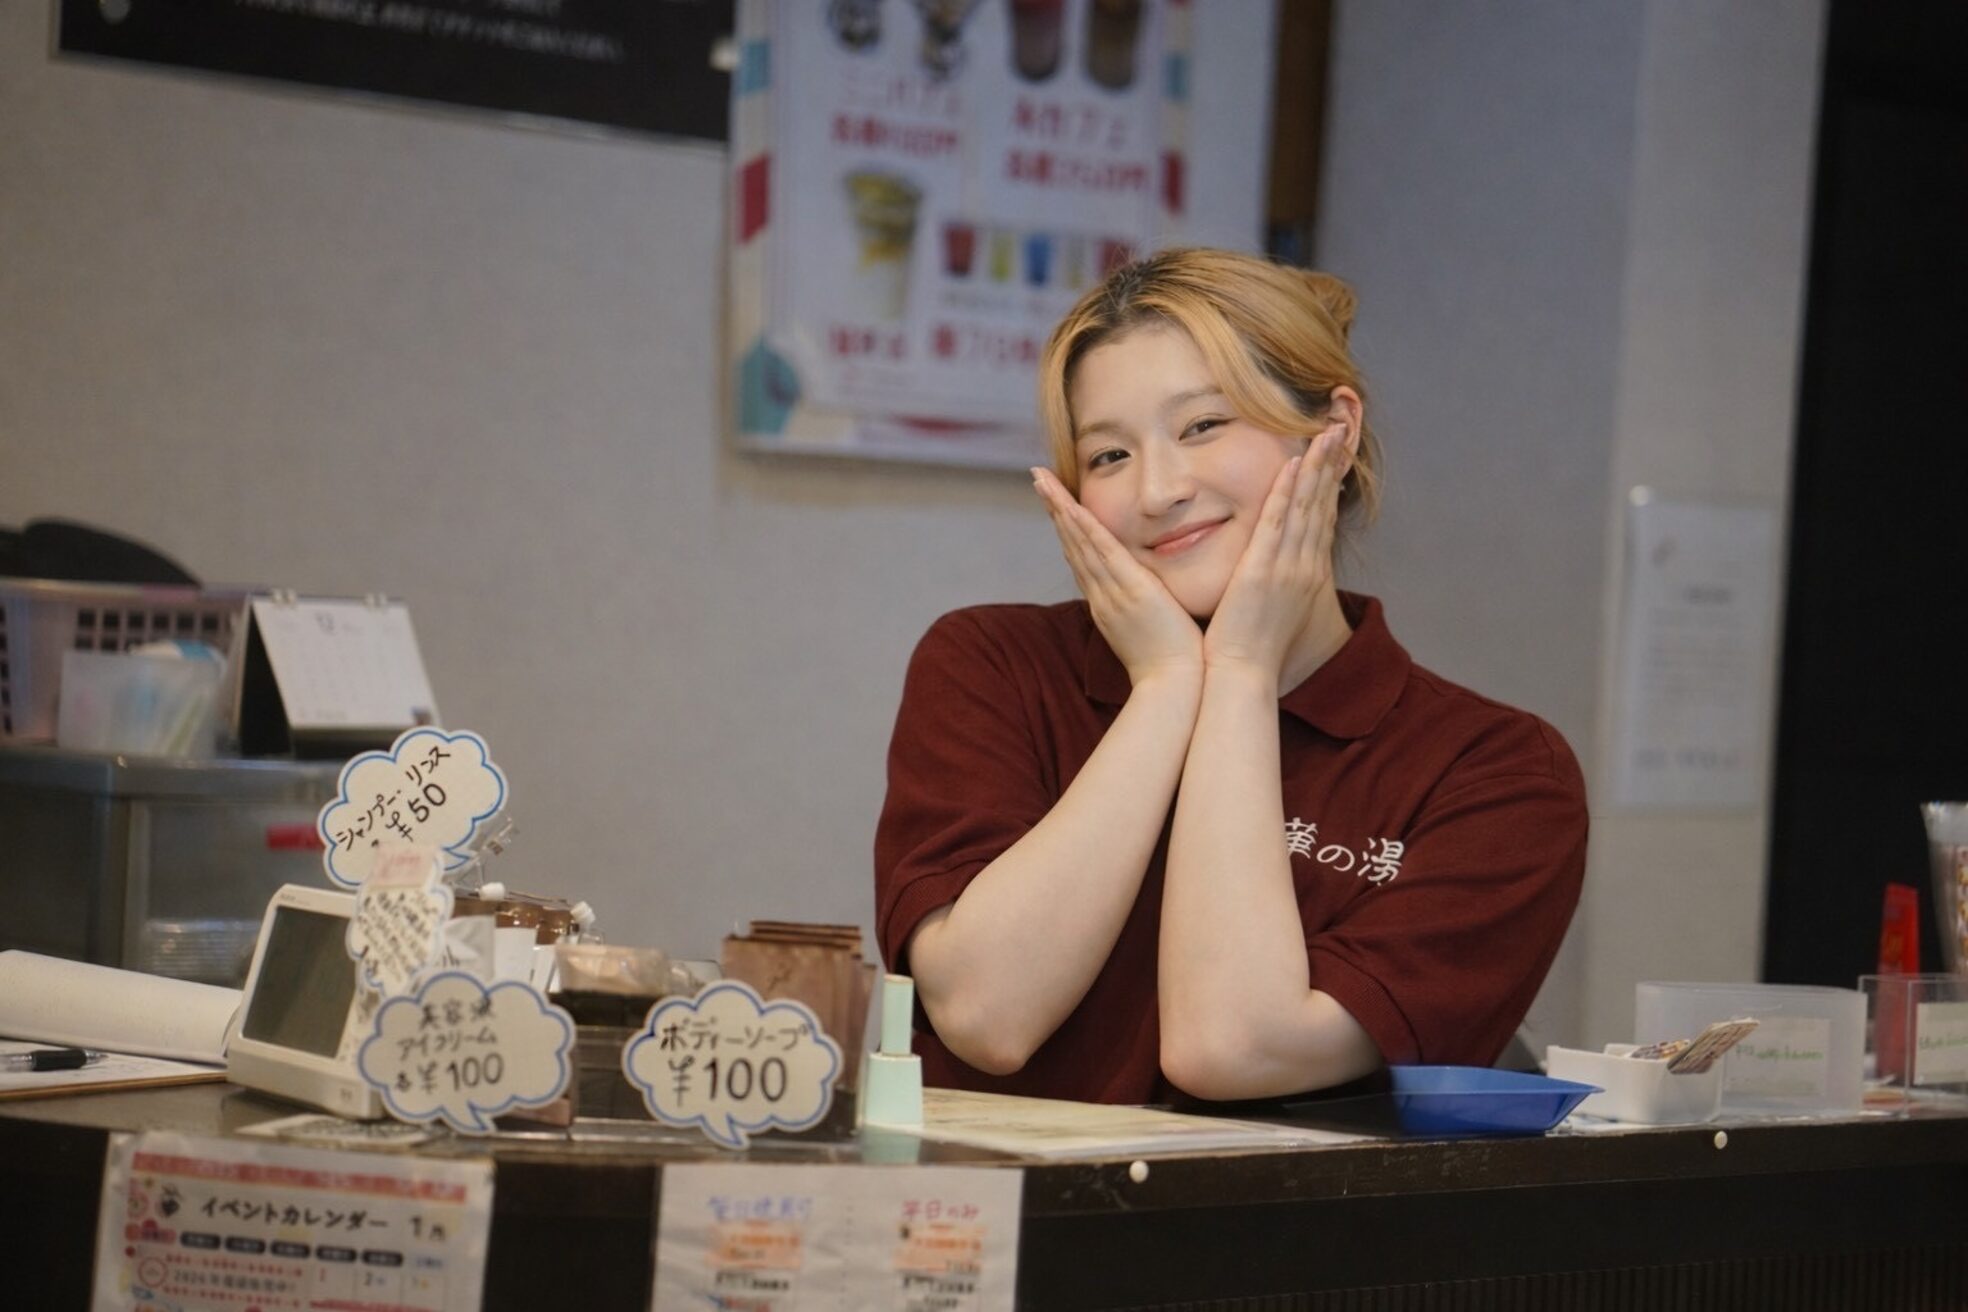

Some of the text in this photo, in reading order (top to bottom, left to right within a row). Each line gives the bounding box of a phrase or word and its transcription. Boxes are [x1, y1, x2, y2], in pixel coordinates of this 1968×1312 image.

[1285, 816, 1405, 886] 華の湯
[660, 1015, 815, 1050] ボディーソープ
[668, 1055, 787, 1107] ¥100
[201, 1197, 388, 1231] イベントカレンダー
